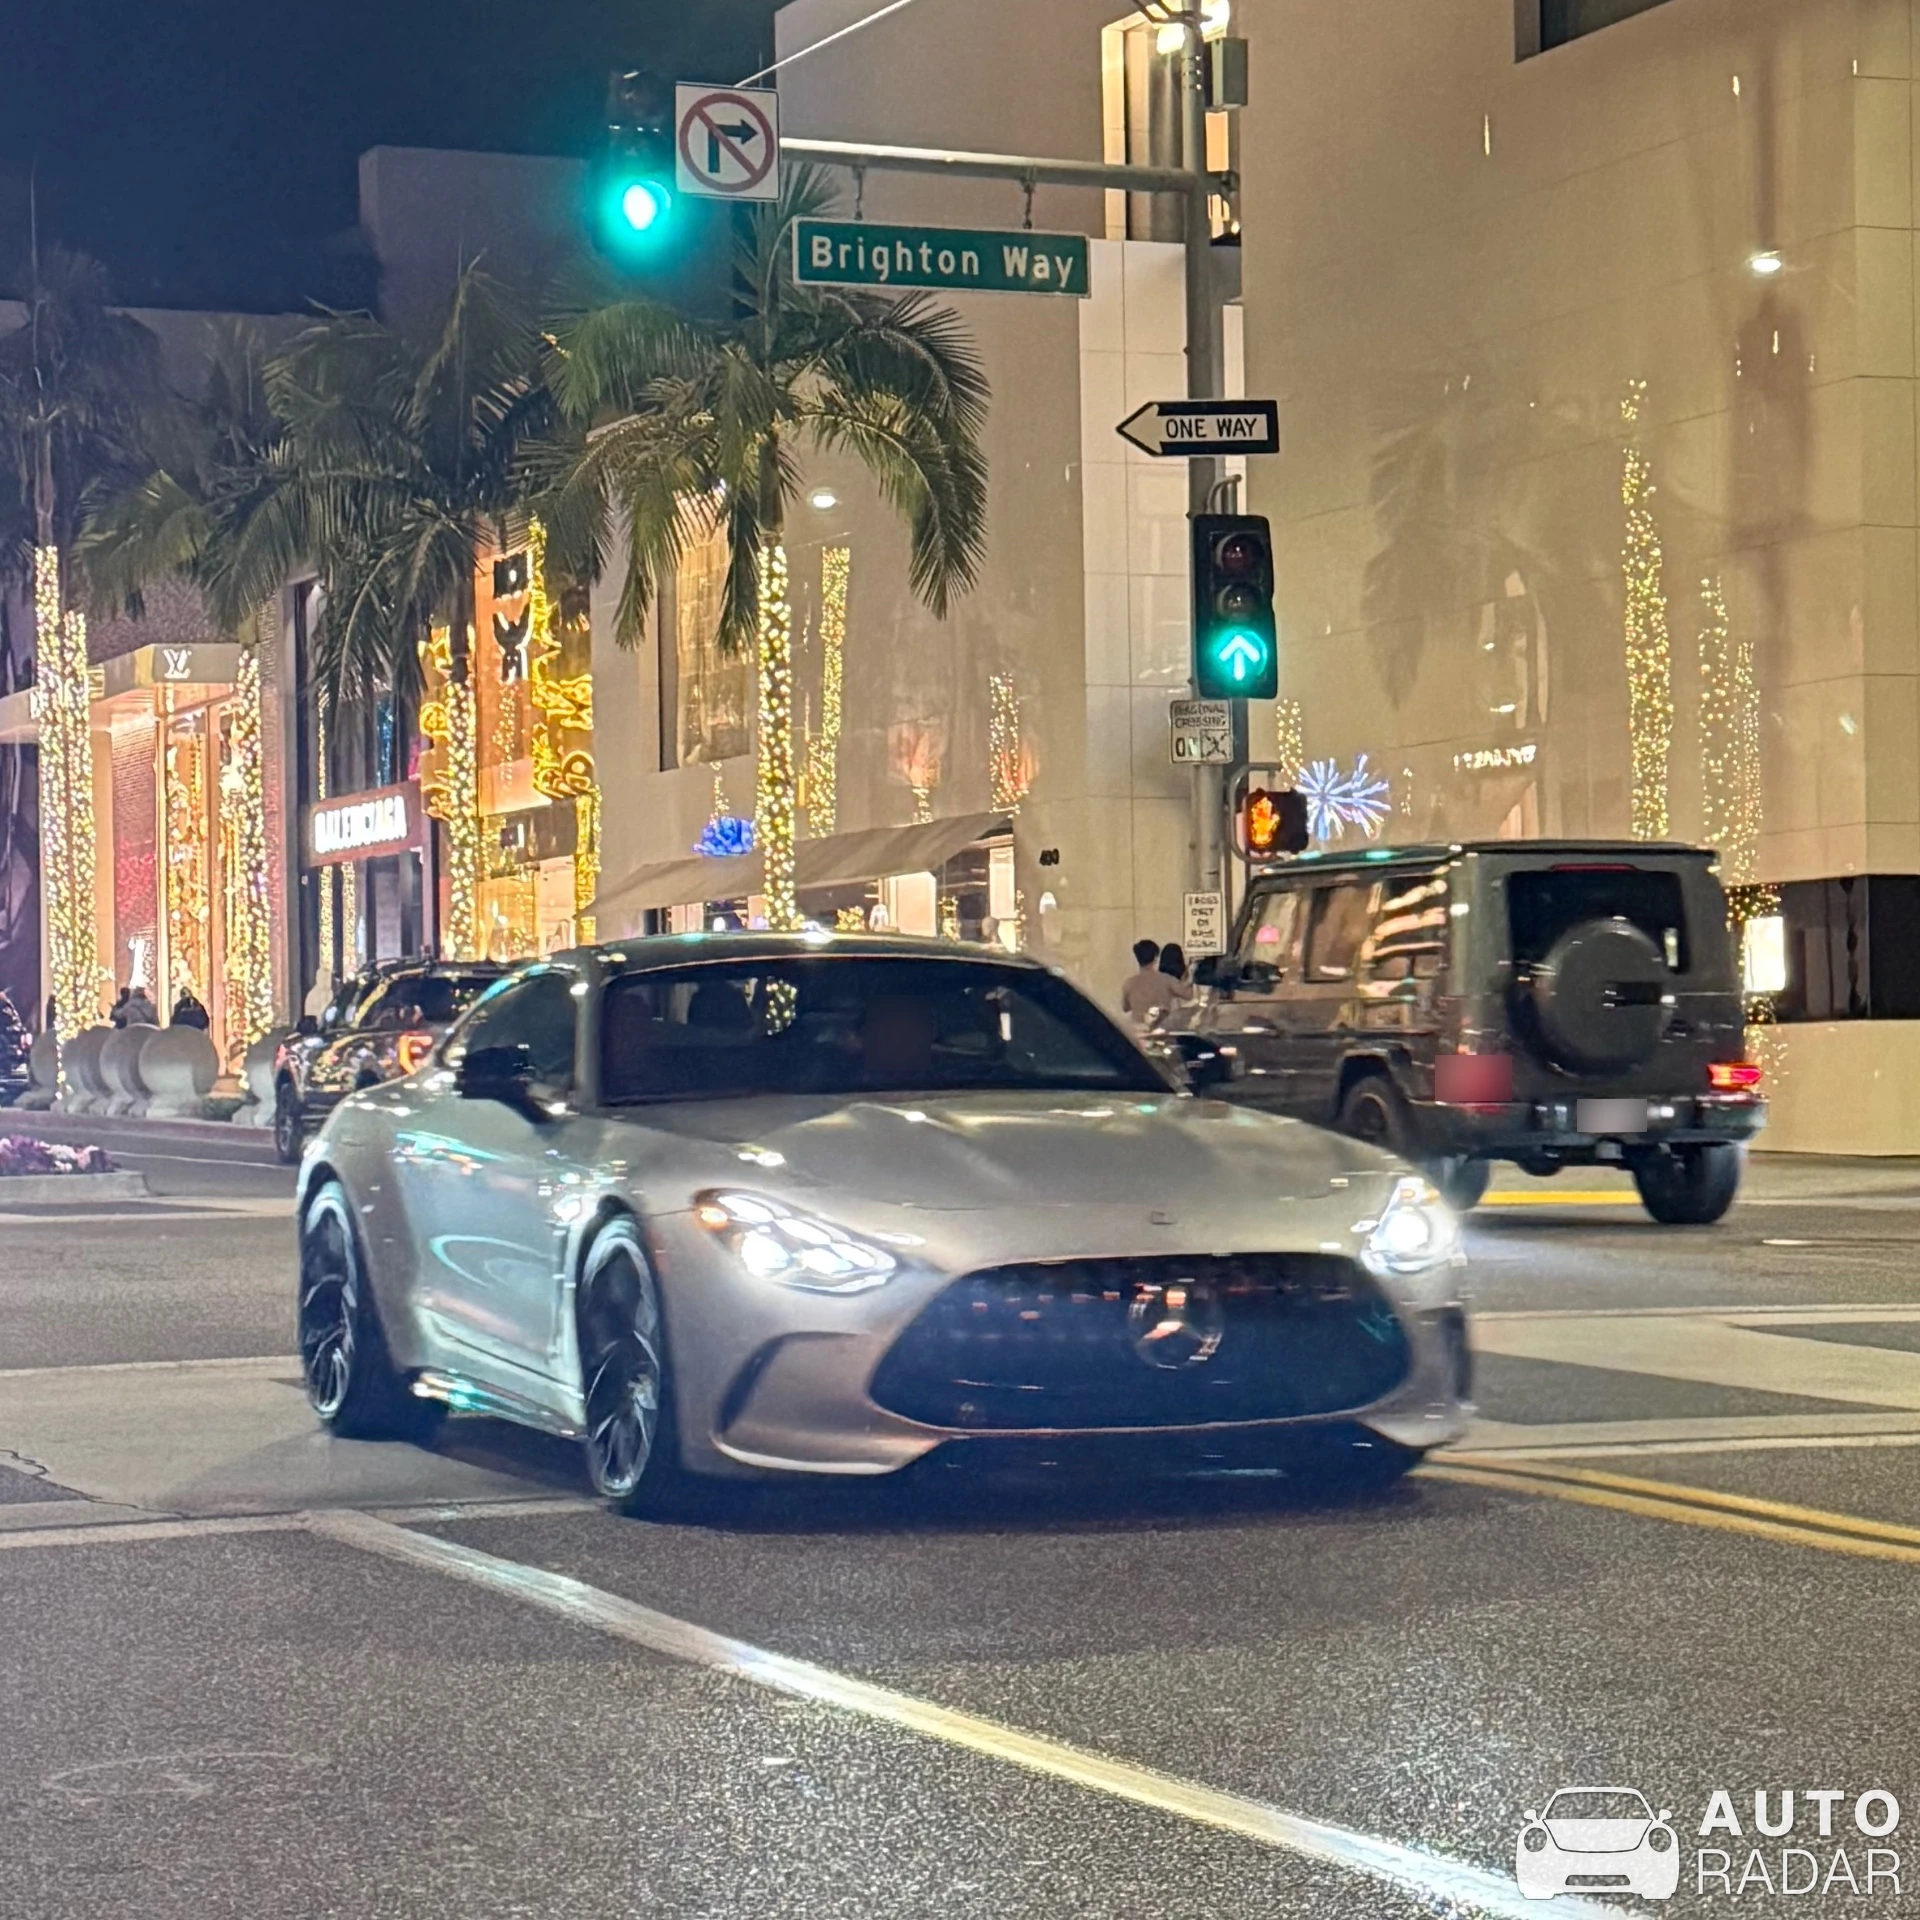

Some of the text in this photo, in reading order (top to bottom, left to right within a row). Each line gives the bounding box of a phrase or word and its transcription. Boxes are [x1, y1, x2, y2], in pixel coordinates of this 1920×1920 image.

[811, 235, 1074, 289] Brighton Way
[1165, 417, 1258, 439] ONE WAY
